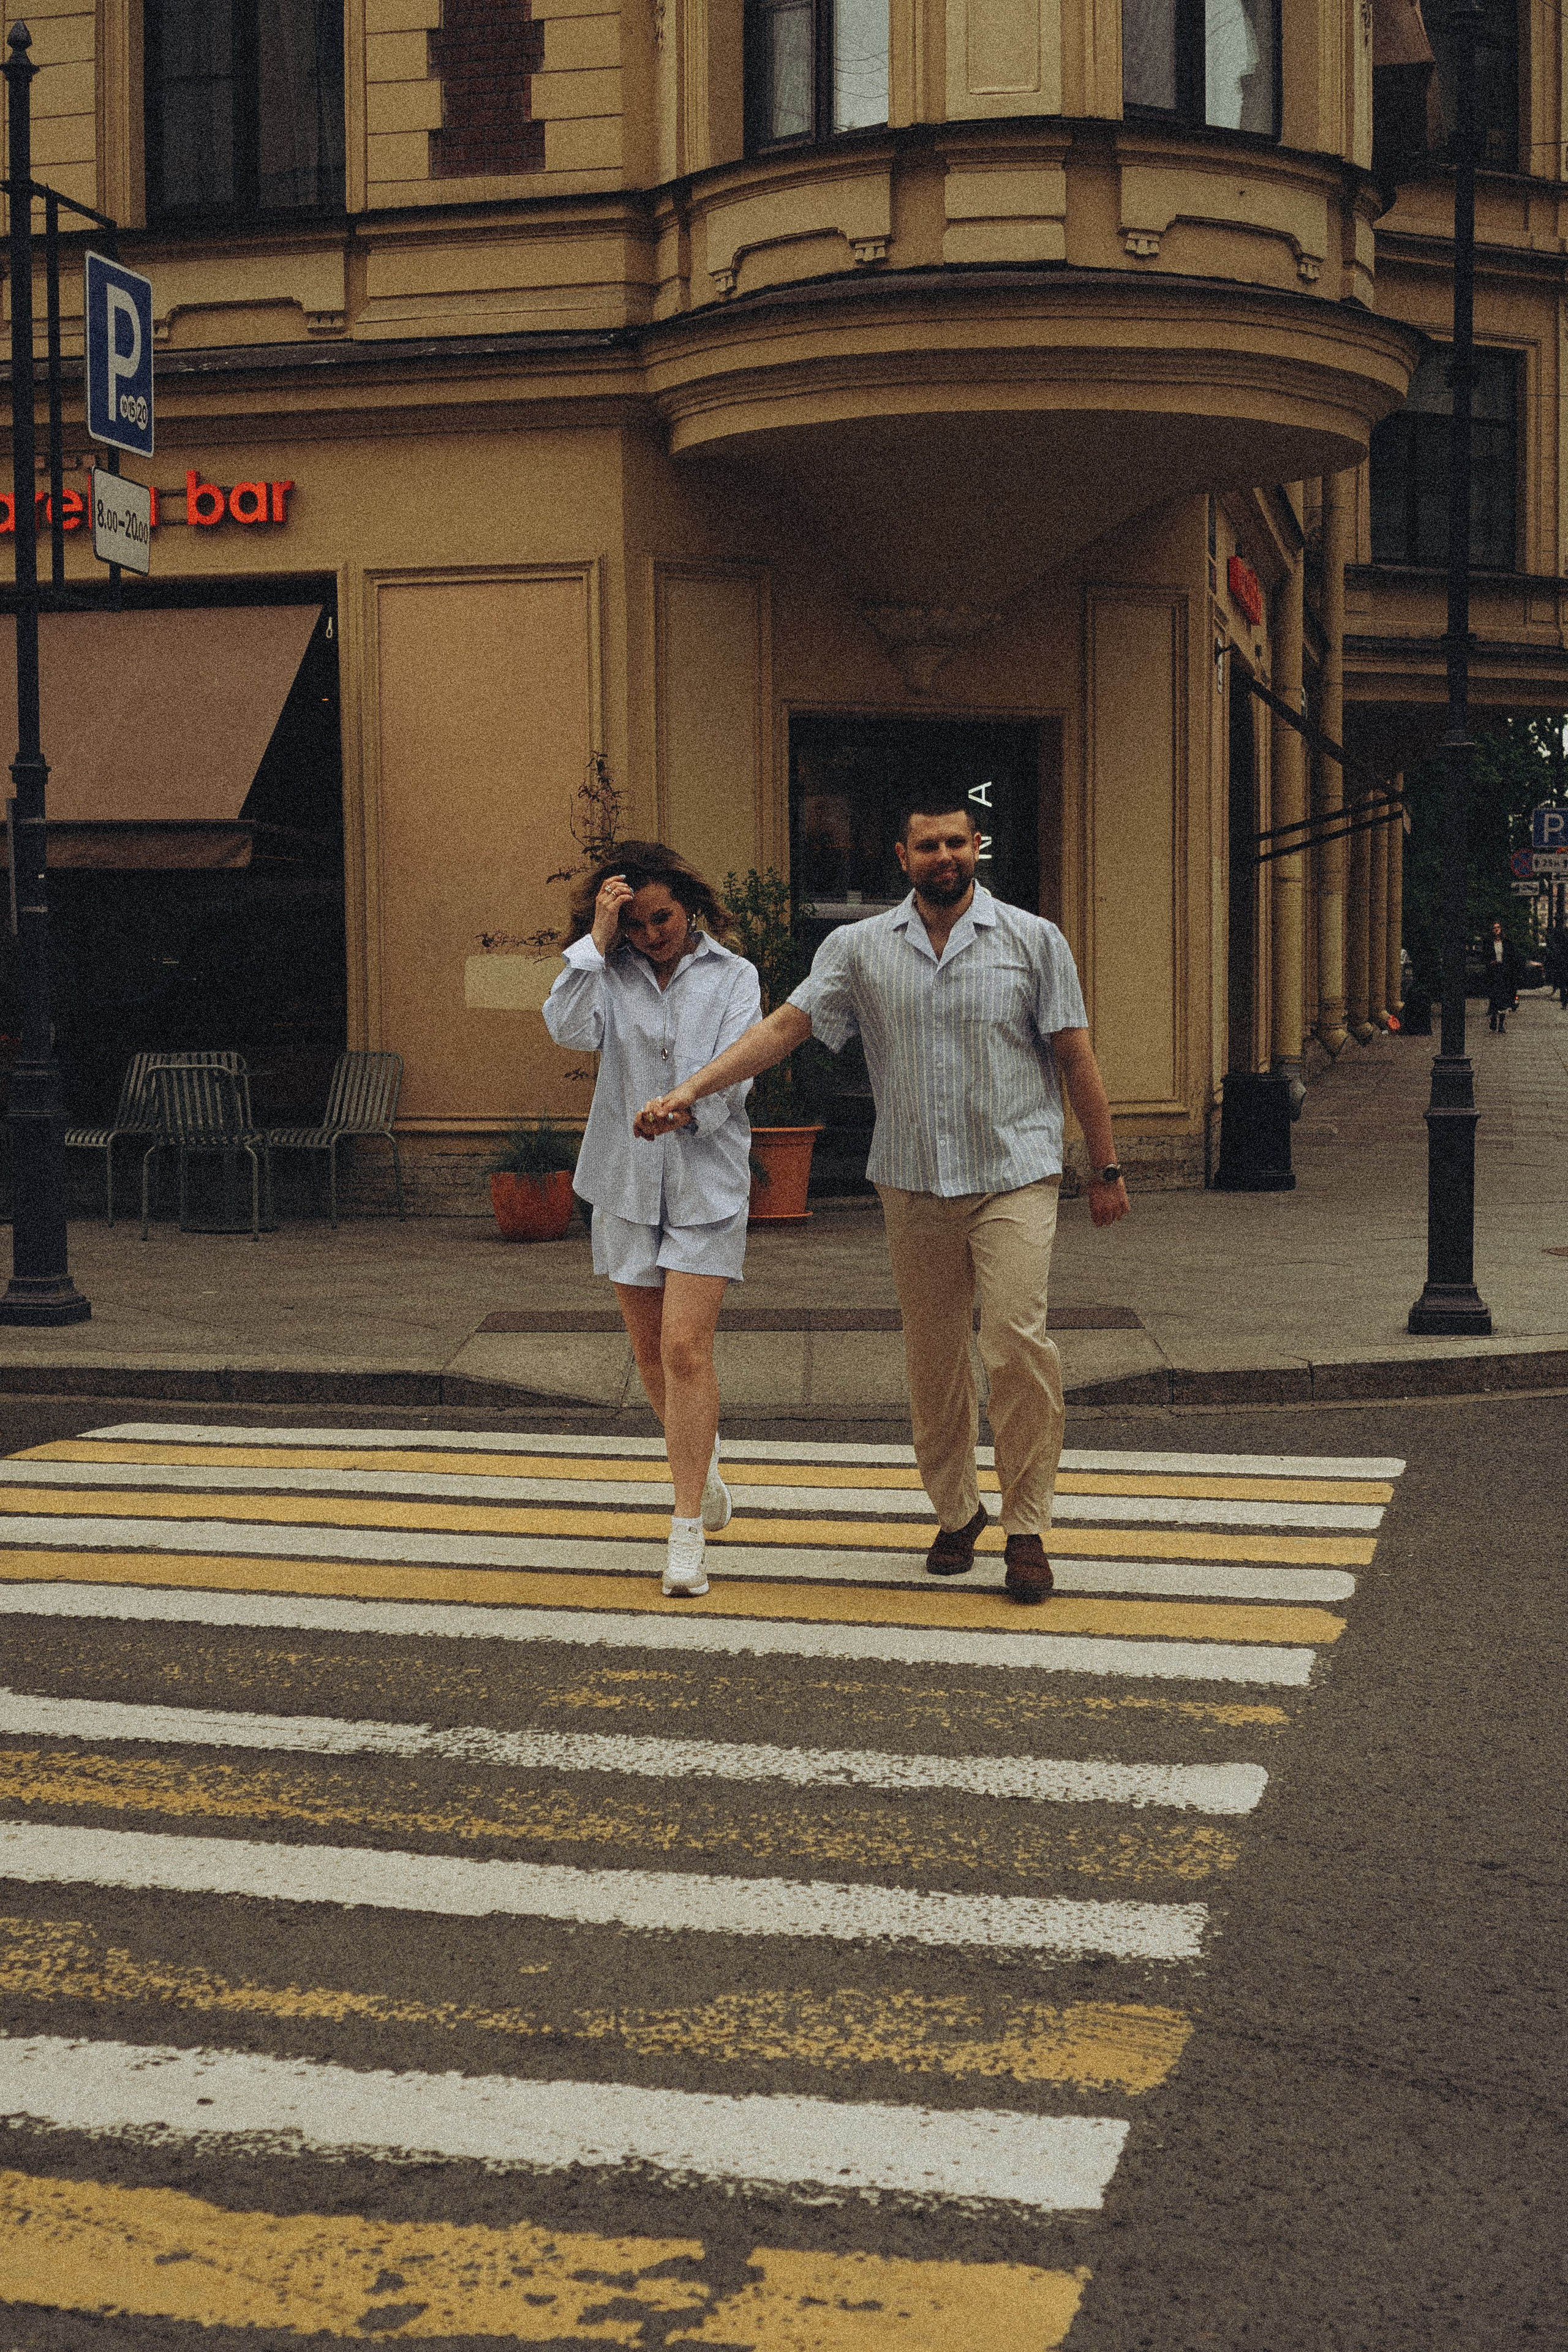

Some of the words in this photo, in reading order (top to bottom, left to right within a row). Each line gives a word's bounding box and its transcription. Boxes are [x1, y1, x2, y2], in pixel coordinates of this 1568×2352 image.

[107, 282, 141, 421] P
[137, 402, 147, 424] 20
[186, 469, 295, 526] bar
[1544, 813, 1565, 843] P
